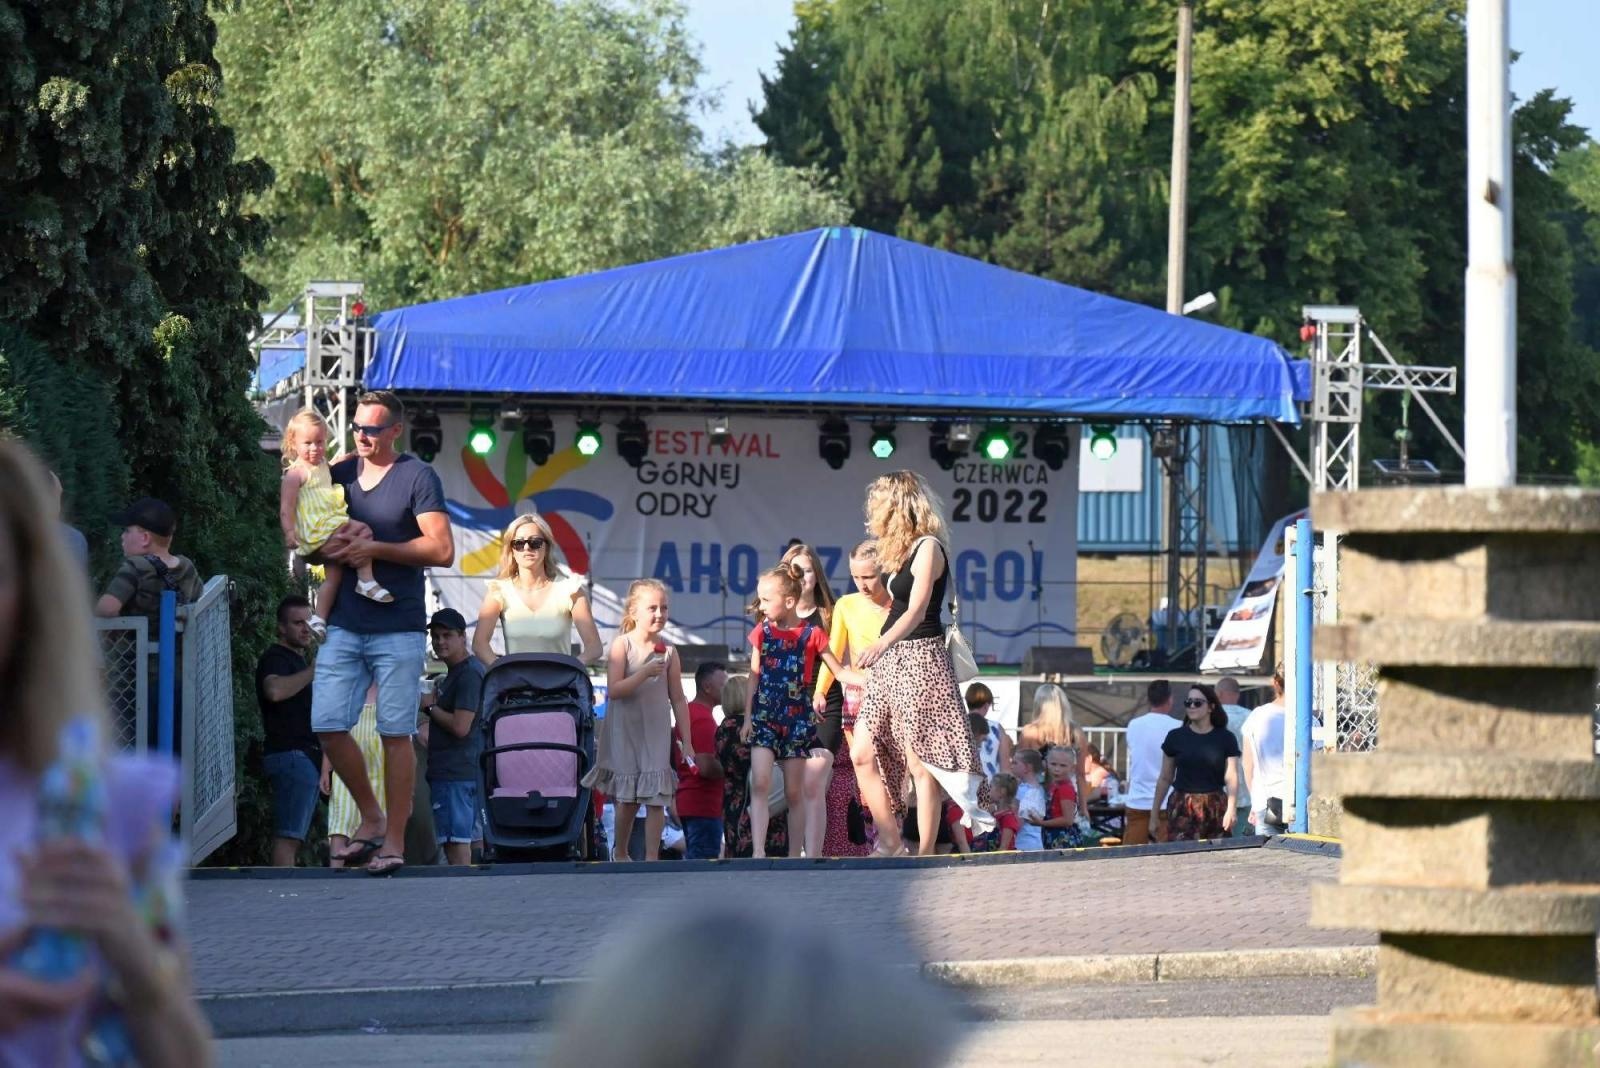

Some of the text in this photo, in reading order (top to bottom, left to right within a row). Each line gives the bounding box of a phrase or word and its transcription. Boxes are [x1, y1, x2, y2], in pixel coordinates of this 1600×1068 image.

[952, 463, 1049, 484] CZERWCA
[636, 491, 717, 518] ODRY
[952, 487, 1048, 523] 2022
[653, 541, 789, 596] AHO
